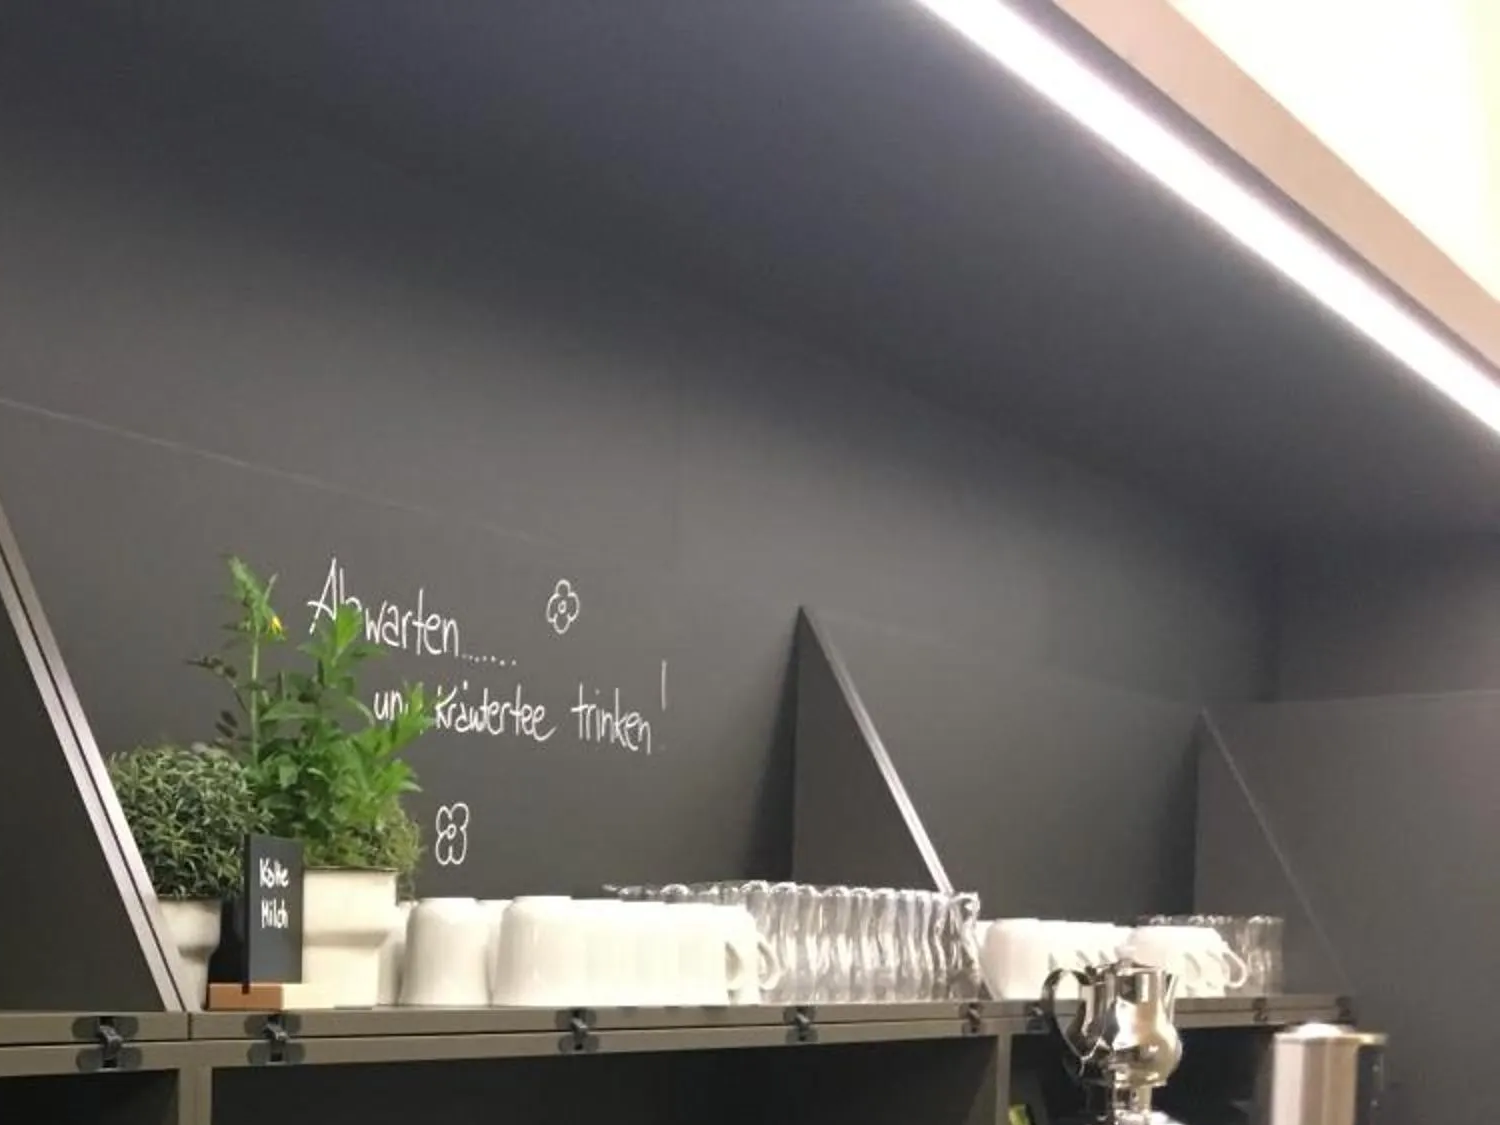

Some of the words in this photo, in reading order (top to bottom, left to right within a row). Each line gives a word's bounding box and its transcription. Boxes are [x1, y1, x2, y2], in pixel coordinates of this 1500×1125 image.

[373, 682, 425, 737] un
[435, 680, 556, 741] Kräutertee
[261, 899, 289, 929] Milch
